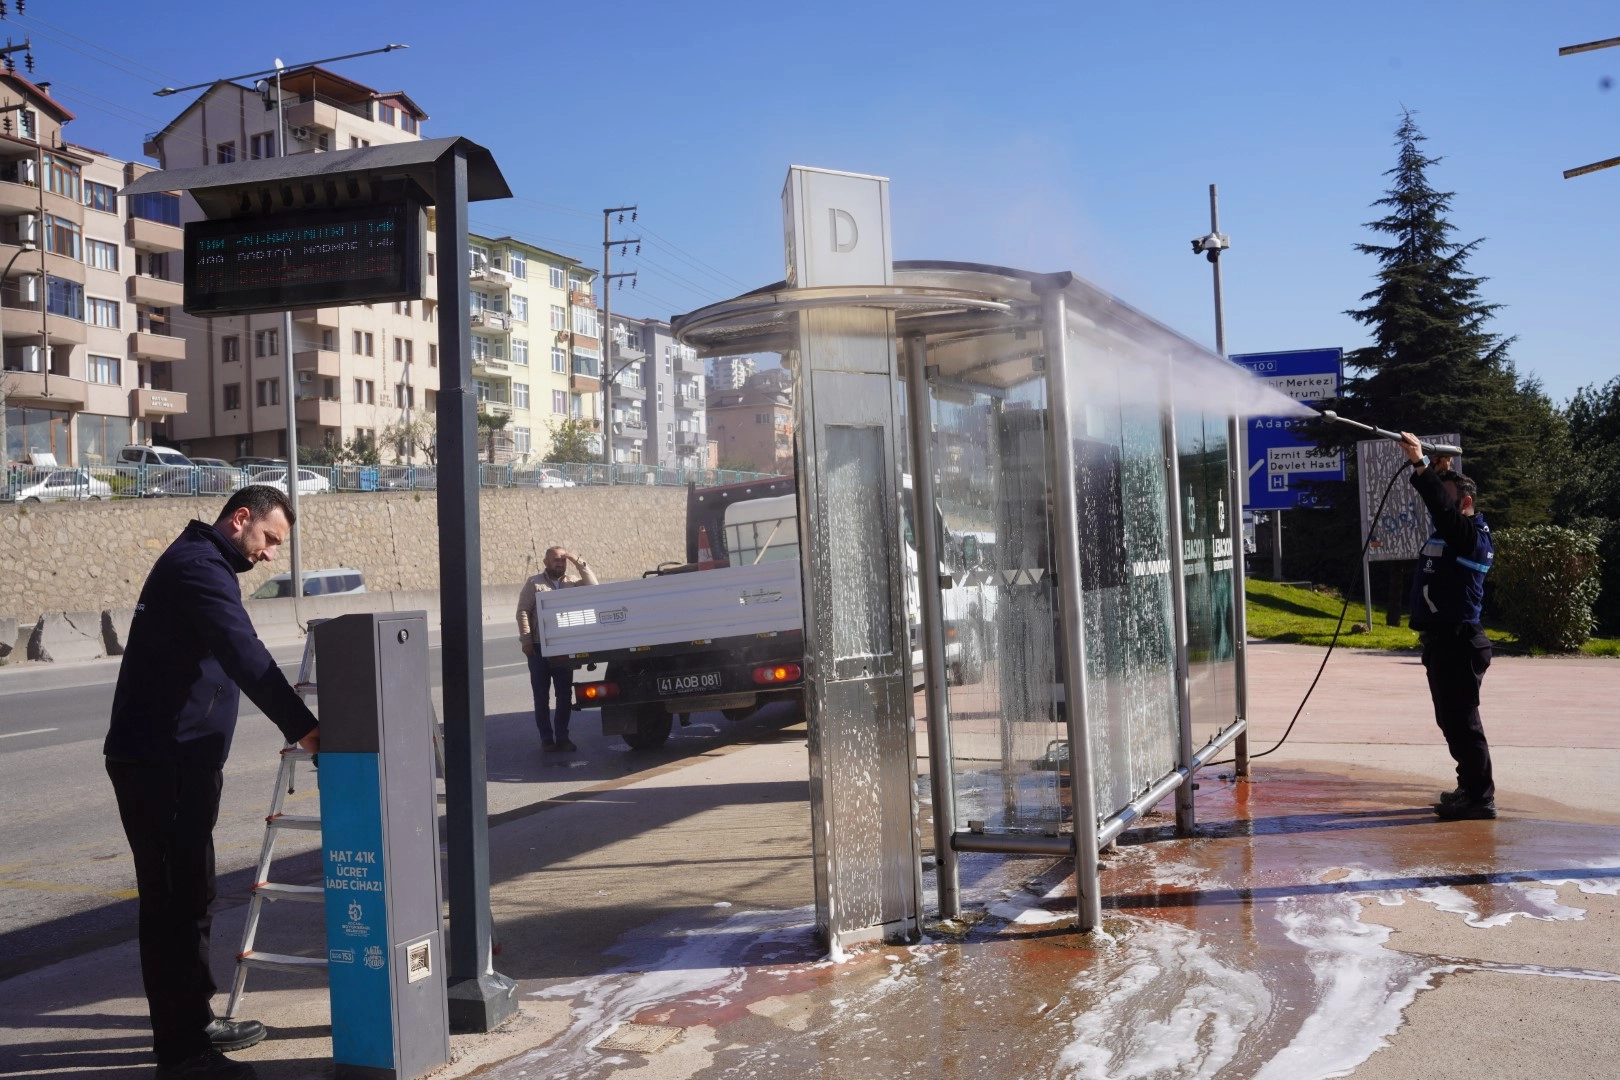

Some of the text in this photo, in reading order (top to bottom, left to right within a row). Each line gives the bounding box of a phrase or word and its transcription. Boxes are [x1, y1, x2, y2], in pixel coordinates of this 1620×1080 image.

[828, 207, 859, 253] D
[1286, 377, 1333, 388] Merkezi
[1269, 450, 1300, 460] İzmit
[1270, 460, 1339, 471] Devlet Hast.
[661, 673, 719, 690] 41 AOB 081
[330, 850, 376, 864] HAT 41K
[336, 864, 368, 878] ÜCRET
[326, 876, 382, 892] İADE CİHAZI
